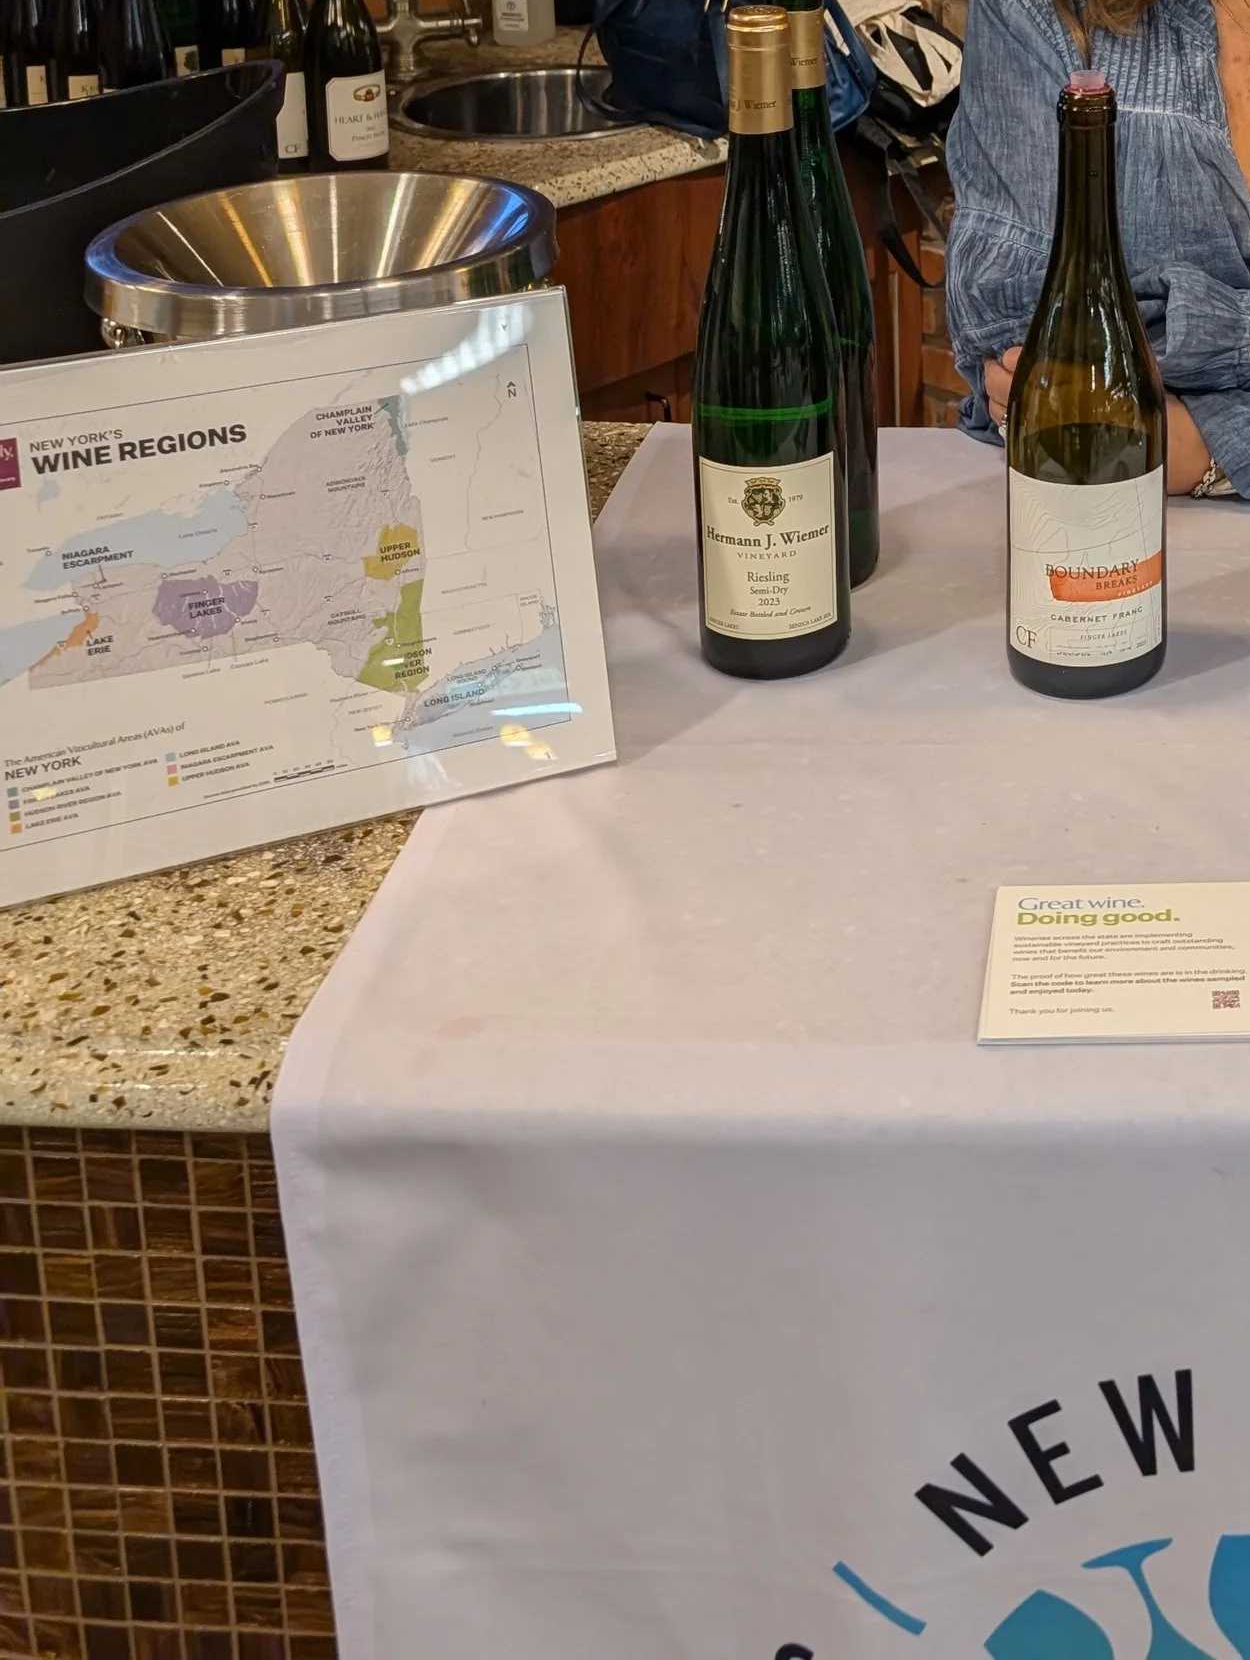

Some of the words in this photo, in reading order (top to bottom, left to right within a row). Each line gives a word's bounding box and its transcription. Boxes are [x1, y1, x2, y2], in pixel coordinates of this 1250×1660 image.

[315, 406, 372, 421] CHAMPLAIN
[335, 413, 372, 426] VALLEY
[309, 429, 322, 438] OF
[324, 425, 346, 436] NEW
[347, 421, 373, 432] YORK
[29, 436, 64, 453] NEW
[66, 429, 123, 446] YORK'S
[31, 444, 112, 475] WINE
[118, 422, 246, 462] REGIONS
[788, 494, 803, 503] 1979
[706, 525, 761, 547] Hermann
[765, 536, 777, 550] J.
[780, 525, 830, 546] Wiemer
[62, 544, 110, 558] NIAGARA
[379, 542, 410, 554] UPPER
[380, 548, 420, 562] HUDSON
[737, 550, 797, 560] VINEYARD
[62, 549, 133, 570] ESCARPMENT
[1045, 558, 1139, 580] BOUNDARY
[747, 571, 790, 583] Riesling
[1095, 574, 1138, 591] BREAKS
[750, 586, 788, 595] Semi-Dry
[188, 597, 225, 611] FINGER
[758, 597, 780, 606] 2023
[190, 605, 222, 619] LAKES
[749, 610, 773, 618] Bottled
[774, 609, 787, 617] and
[1050, 614, 1107, 623] CABERNET
[1112, 606, 1143, 620] FRANC
[86, 634, 113, 648] LAKE
[1016, 625, 1037, 649] CF
[1107, 630, 1127, 639] LAKES
[87, 644, 111, 657] ERIE
[394, 664, 429, 679] REGION
[423, 694, 449, 707] LONG
[450, 687, 486, 700] ISLAND
[4, 764, 38, 780] NEW
[40, 755, 81, 772] YORK
[1017, 897, 1083, 910] Great
[1087, 896, 1144, 908] wine.
[1017, 910, 1097, 928] Doing
[1102, 908, 1180, 926] good.
[914, 1368, 1197, 1557] NEW
